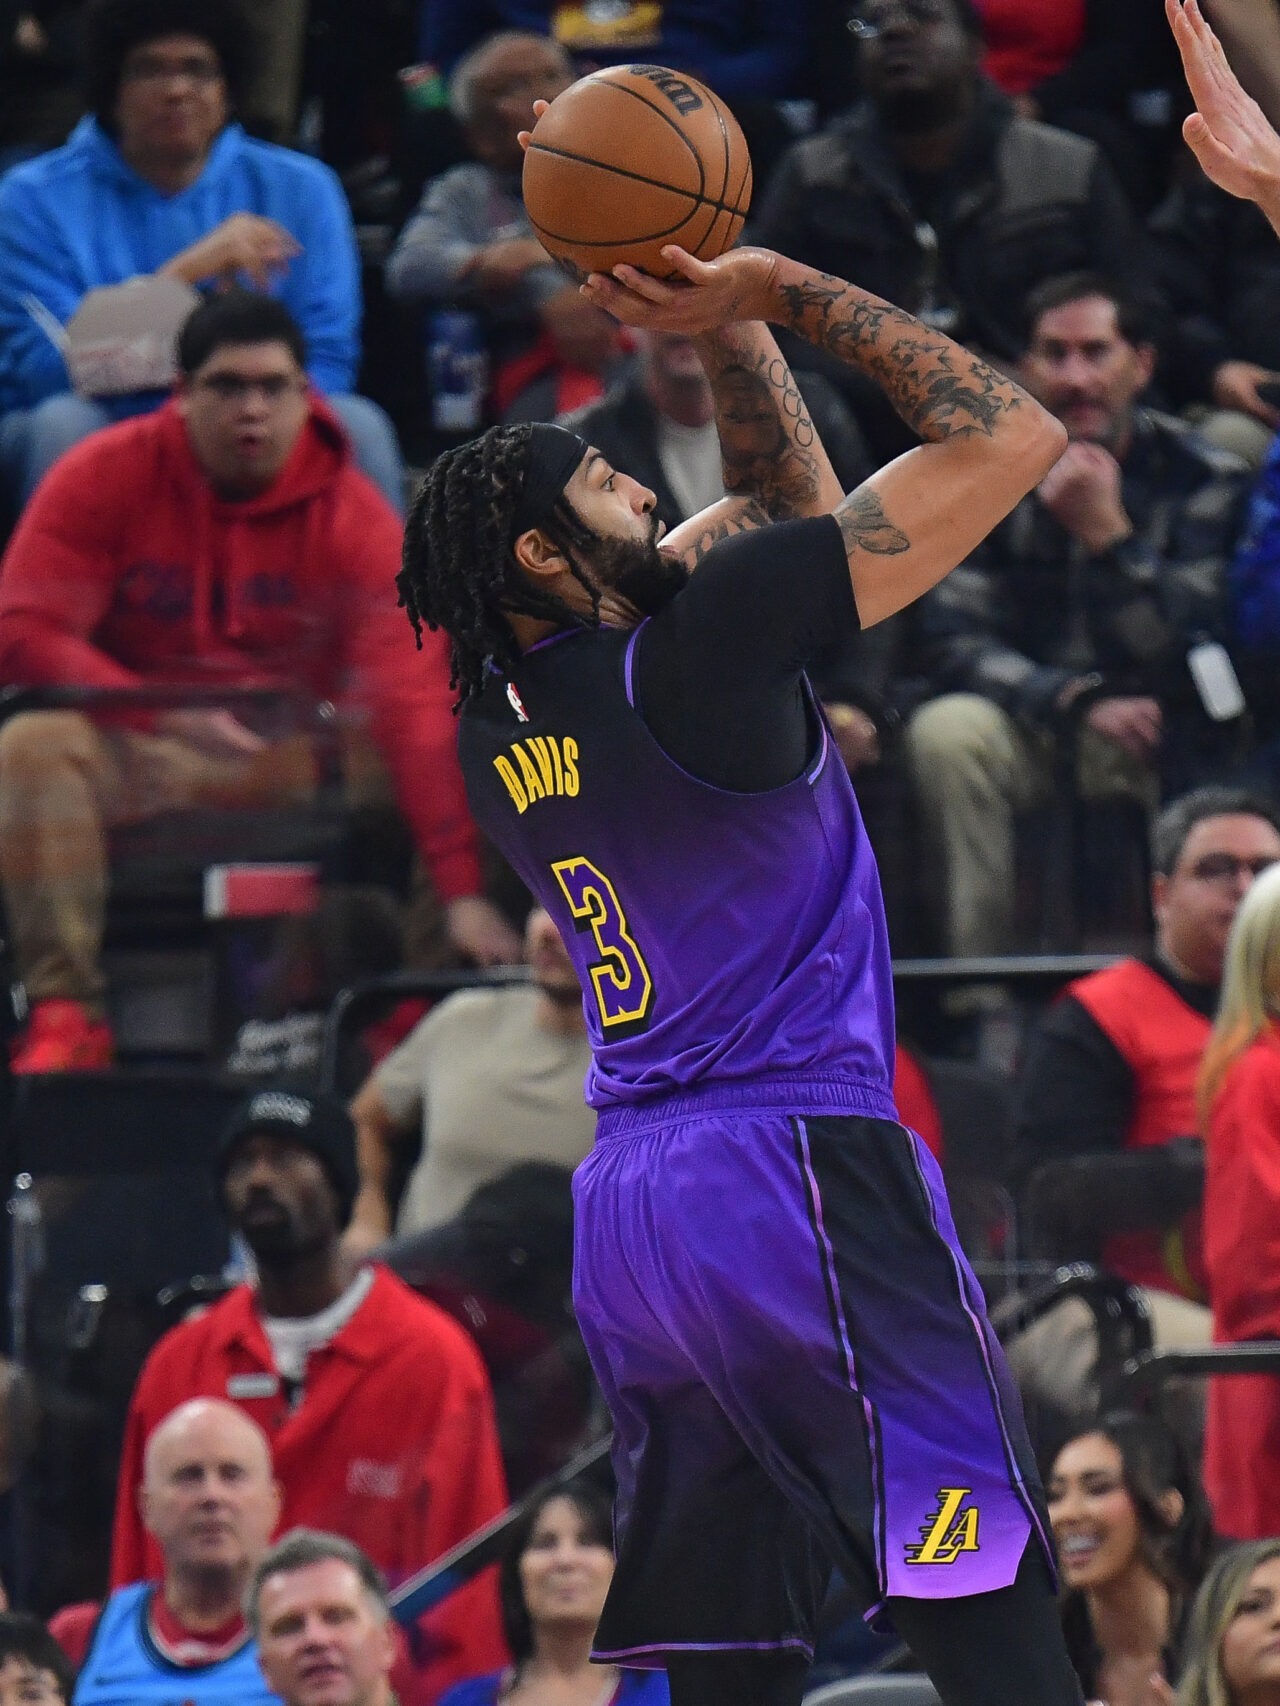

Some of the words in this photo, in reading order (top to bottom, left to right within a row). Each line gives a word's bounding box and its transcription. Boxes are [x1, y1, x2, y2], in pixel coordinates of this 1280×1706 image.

[493, 736, 580, 814] DAVIS
[550, 856, 657, 1046] 3
[904, 1486, 980, 1565] LA
